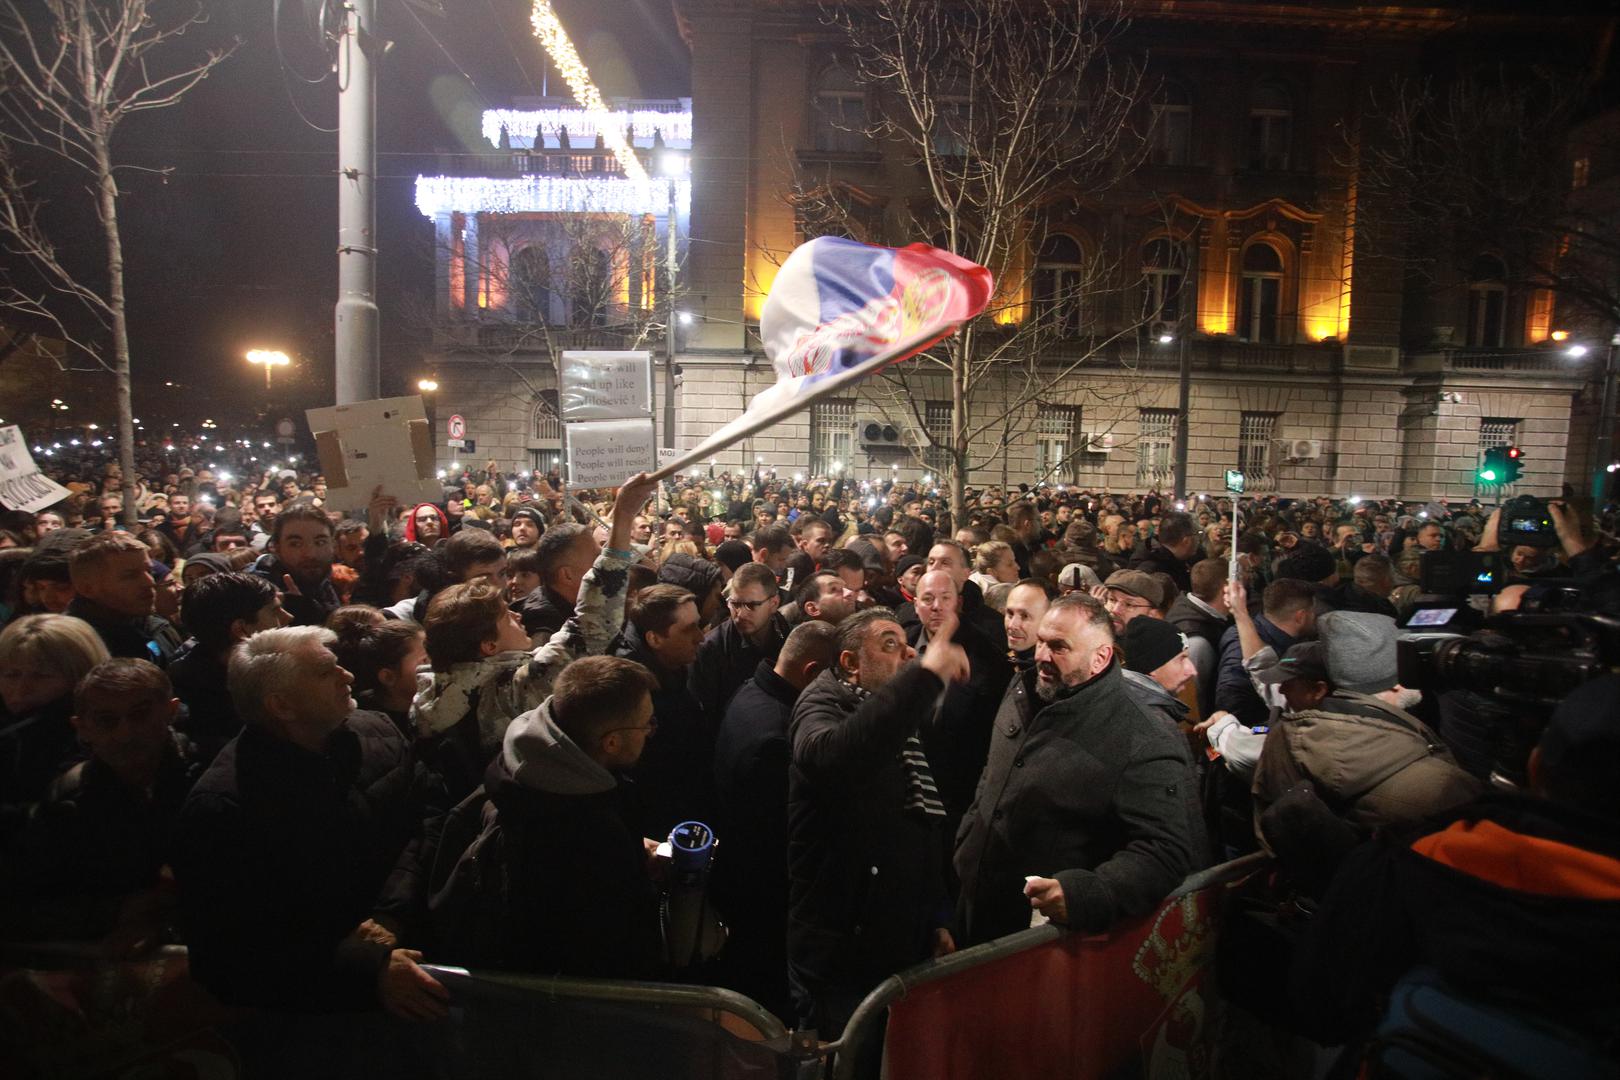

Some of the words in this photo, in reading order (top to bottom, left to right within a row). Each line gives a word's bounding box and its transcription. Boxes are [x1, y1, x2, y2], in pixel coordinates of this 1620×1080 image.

[617, 362, 636, 373] will
[599, 381, 613, 393] up
[615, 379, 635, 390] like
[575, 447, 605, 457] People
[607, 445, 624, 455] will
[626, 443, 649, 455] deny!
[575, 460, 605, 470] People
[607, 458, 624, 468] will
[626, 457, 651, 467] resist!
[577, 473, 608, 484] People
[609, 471, 626, 482] will
